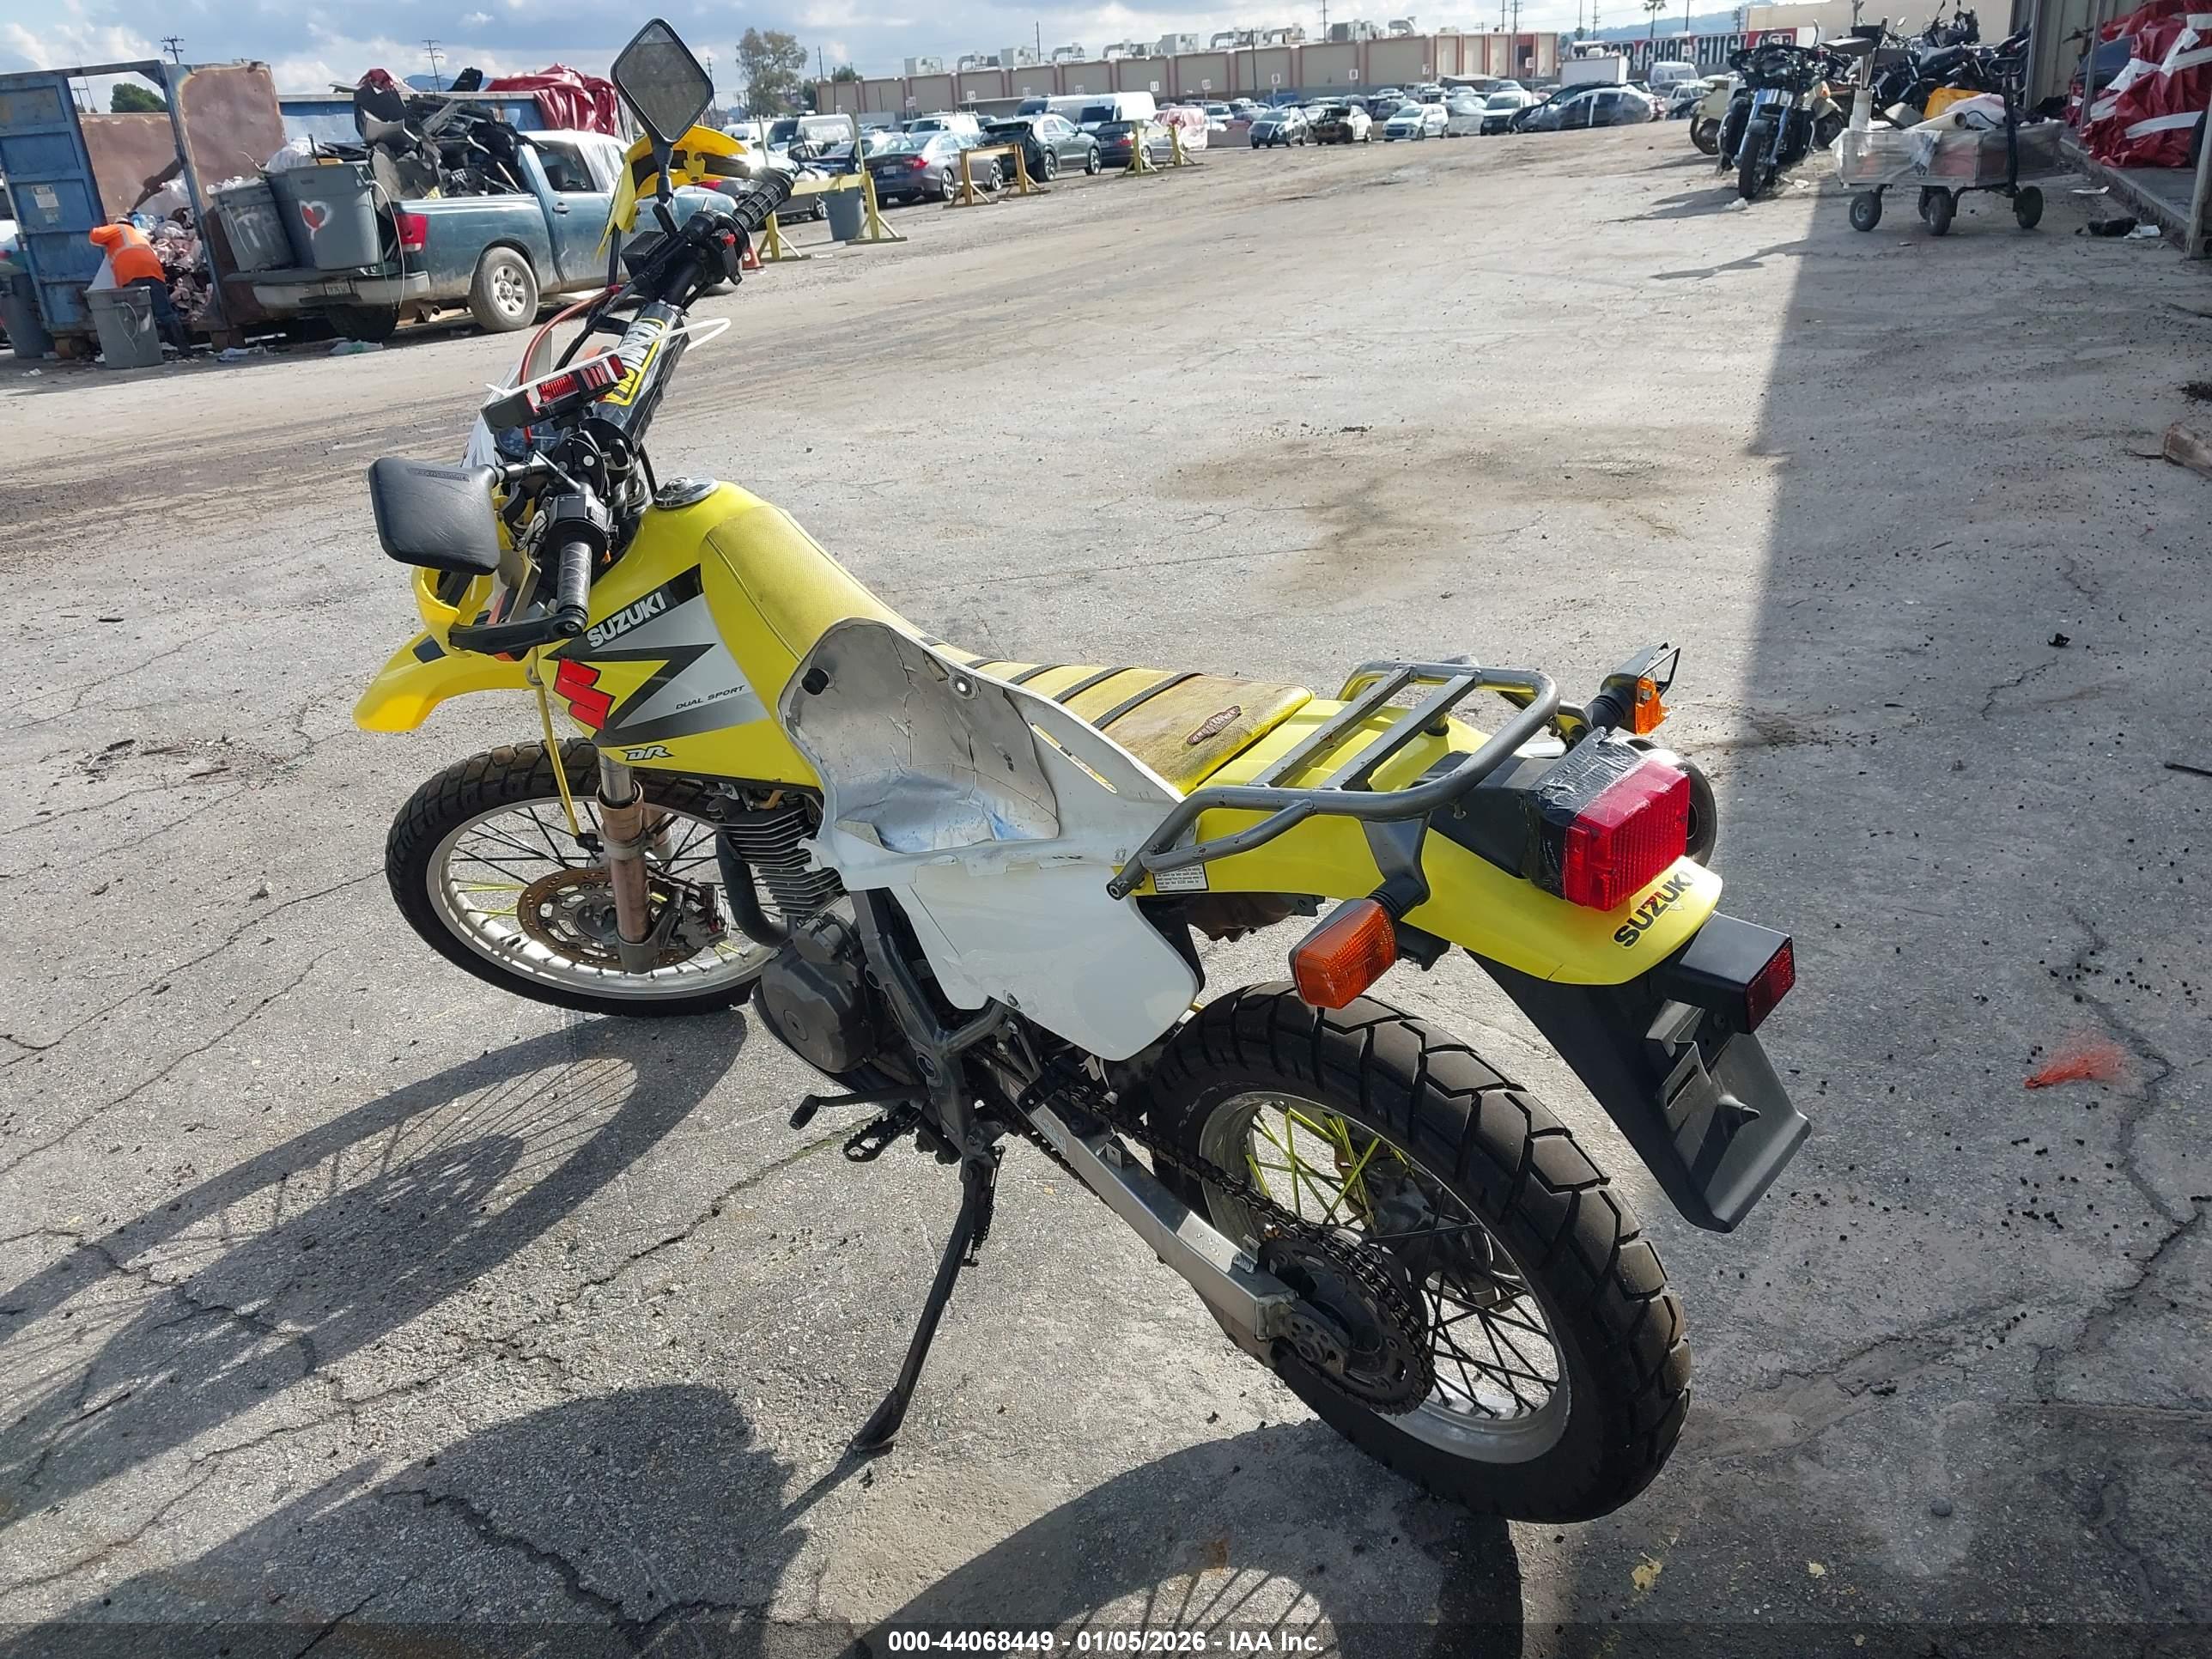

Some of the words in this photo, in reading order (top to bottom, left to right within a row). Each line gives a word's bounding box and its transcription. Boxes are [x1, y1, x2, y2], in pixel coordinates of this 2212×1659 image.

[587, 592, 666, 647] SUZUKI
[676, 698, 704, 710] DUAL
[708, 685, 746, 701] SPORT
[623, 745, 673, 762] DR
[1613, 871, 1694, 947] SUZUKI
